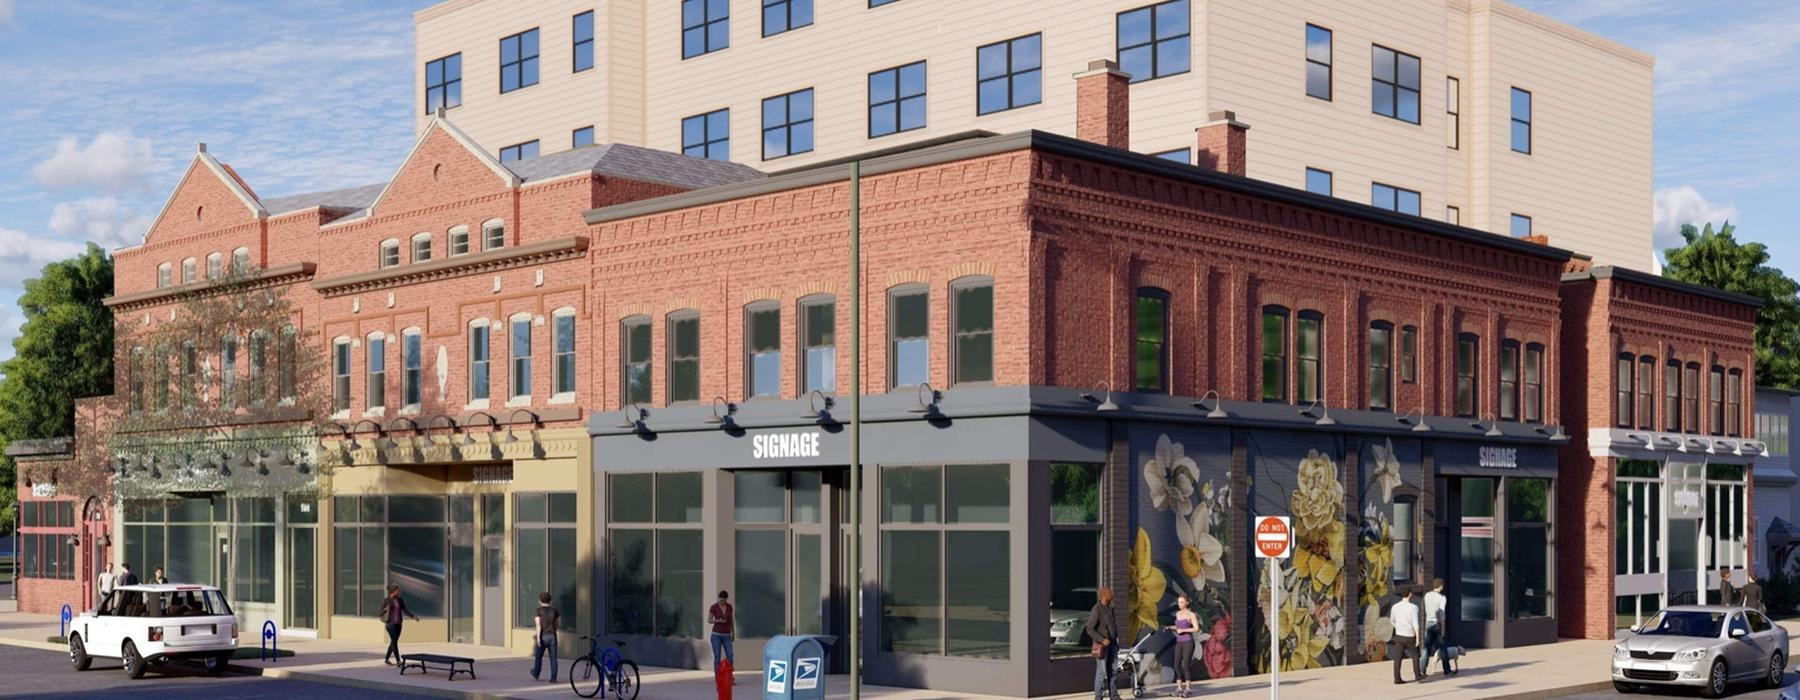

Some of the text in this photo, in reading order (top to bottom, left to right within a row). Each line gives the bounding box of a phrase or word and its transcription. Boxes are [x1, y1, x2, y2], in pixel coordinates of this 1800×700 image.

[753, 432, 820, 459] SIGNAGE
[1480, 446, 1517, 468] SIGNAGE
[1260, 523, 1285, 532] DO NOT
[1262, 542, 1282, 551] ENTER
